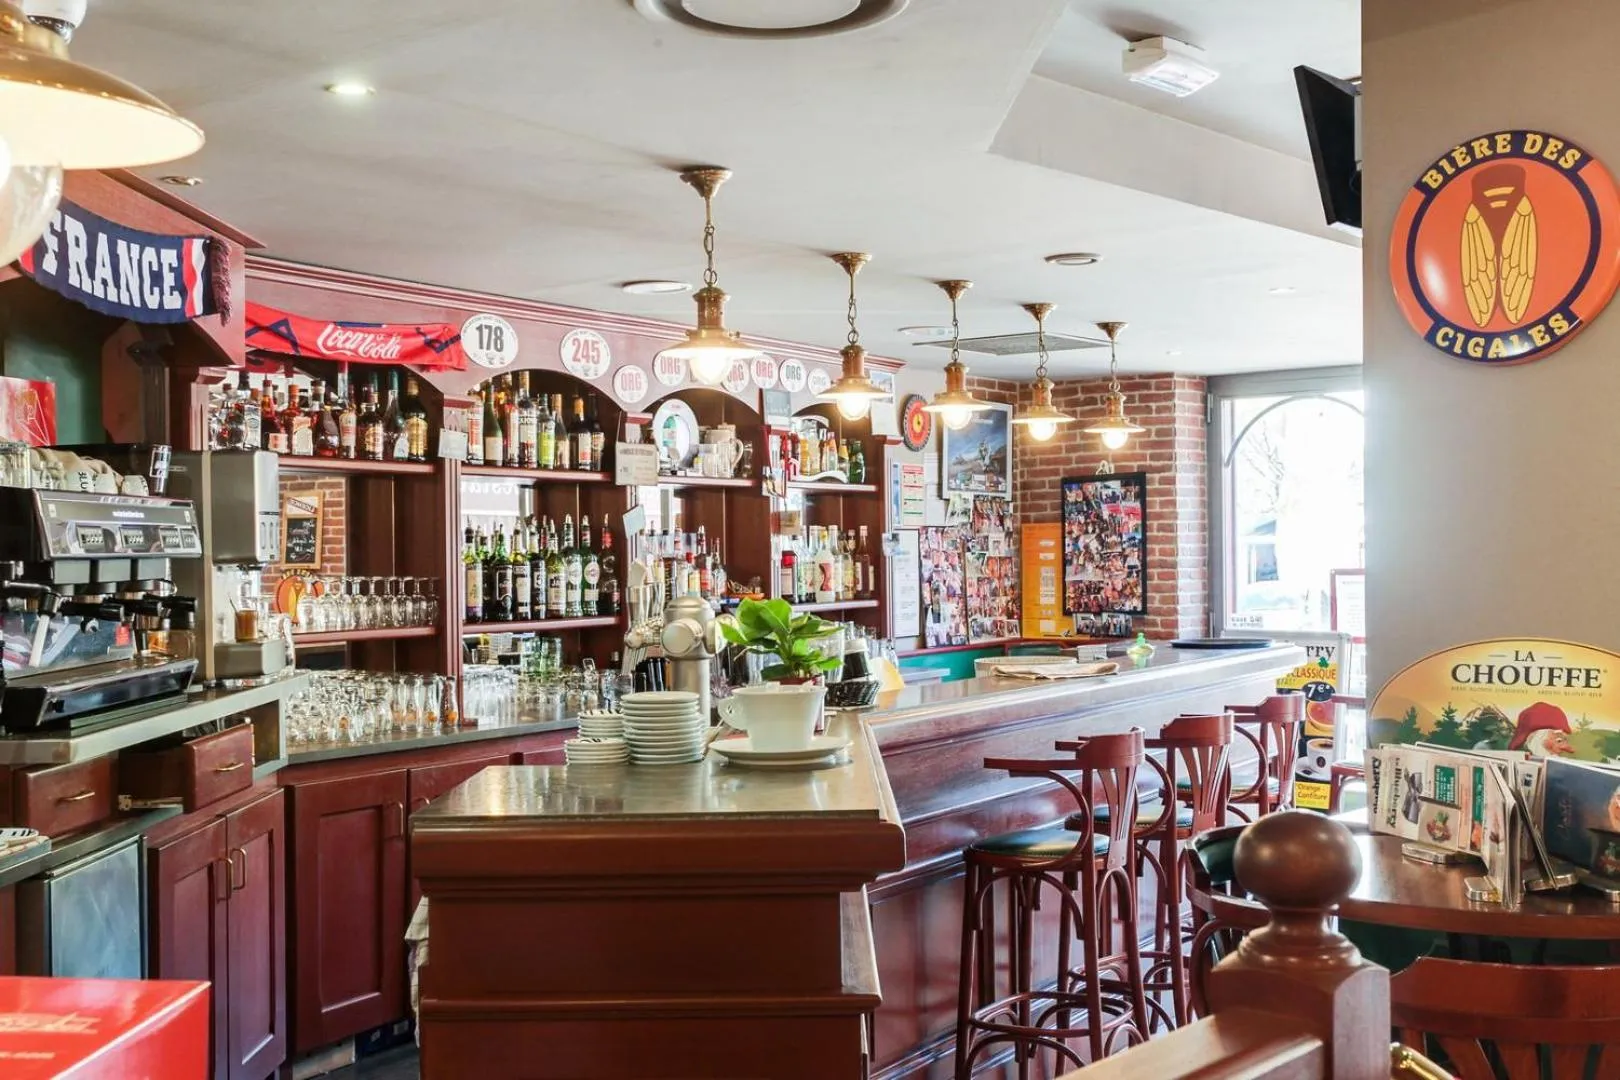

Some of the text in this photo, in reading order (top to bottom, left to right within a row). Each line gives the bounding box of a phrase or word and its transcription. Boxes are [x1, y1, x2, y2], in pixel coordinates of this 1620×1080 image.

[1422, 133, 1581, 189] BIÈRE DES
[42, 209, 182, 310] FRANCE
[475, 324, 504, 352] 178
[1435, 313, 1570, 359] CIGALES
[572, 337, 600, 365] 245
[621, 377, 641, 391] ORG
[756, 362, 773, 379] ORG
[785, 364, 801, 380] ORG
[1513, 650, 1536, 662] LA
[1451, 663, 1602, 689] CHOUFFE
